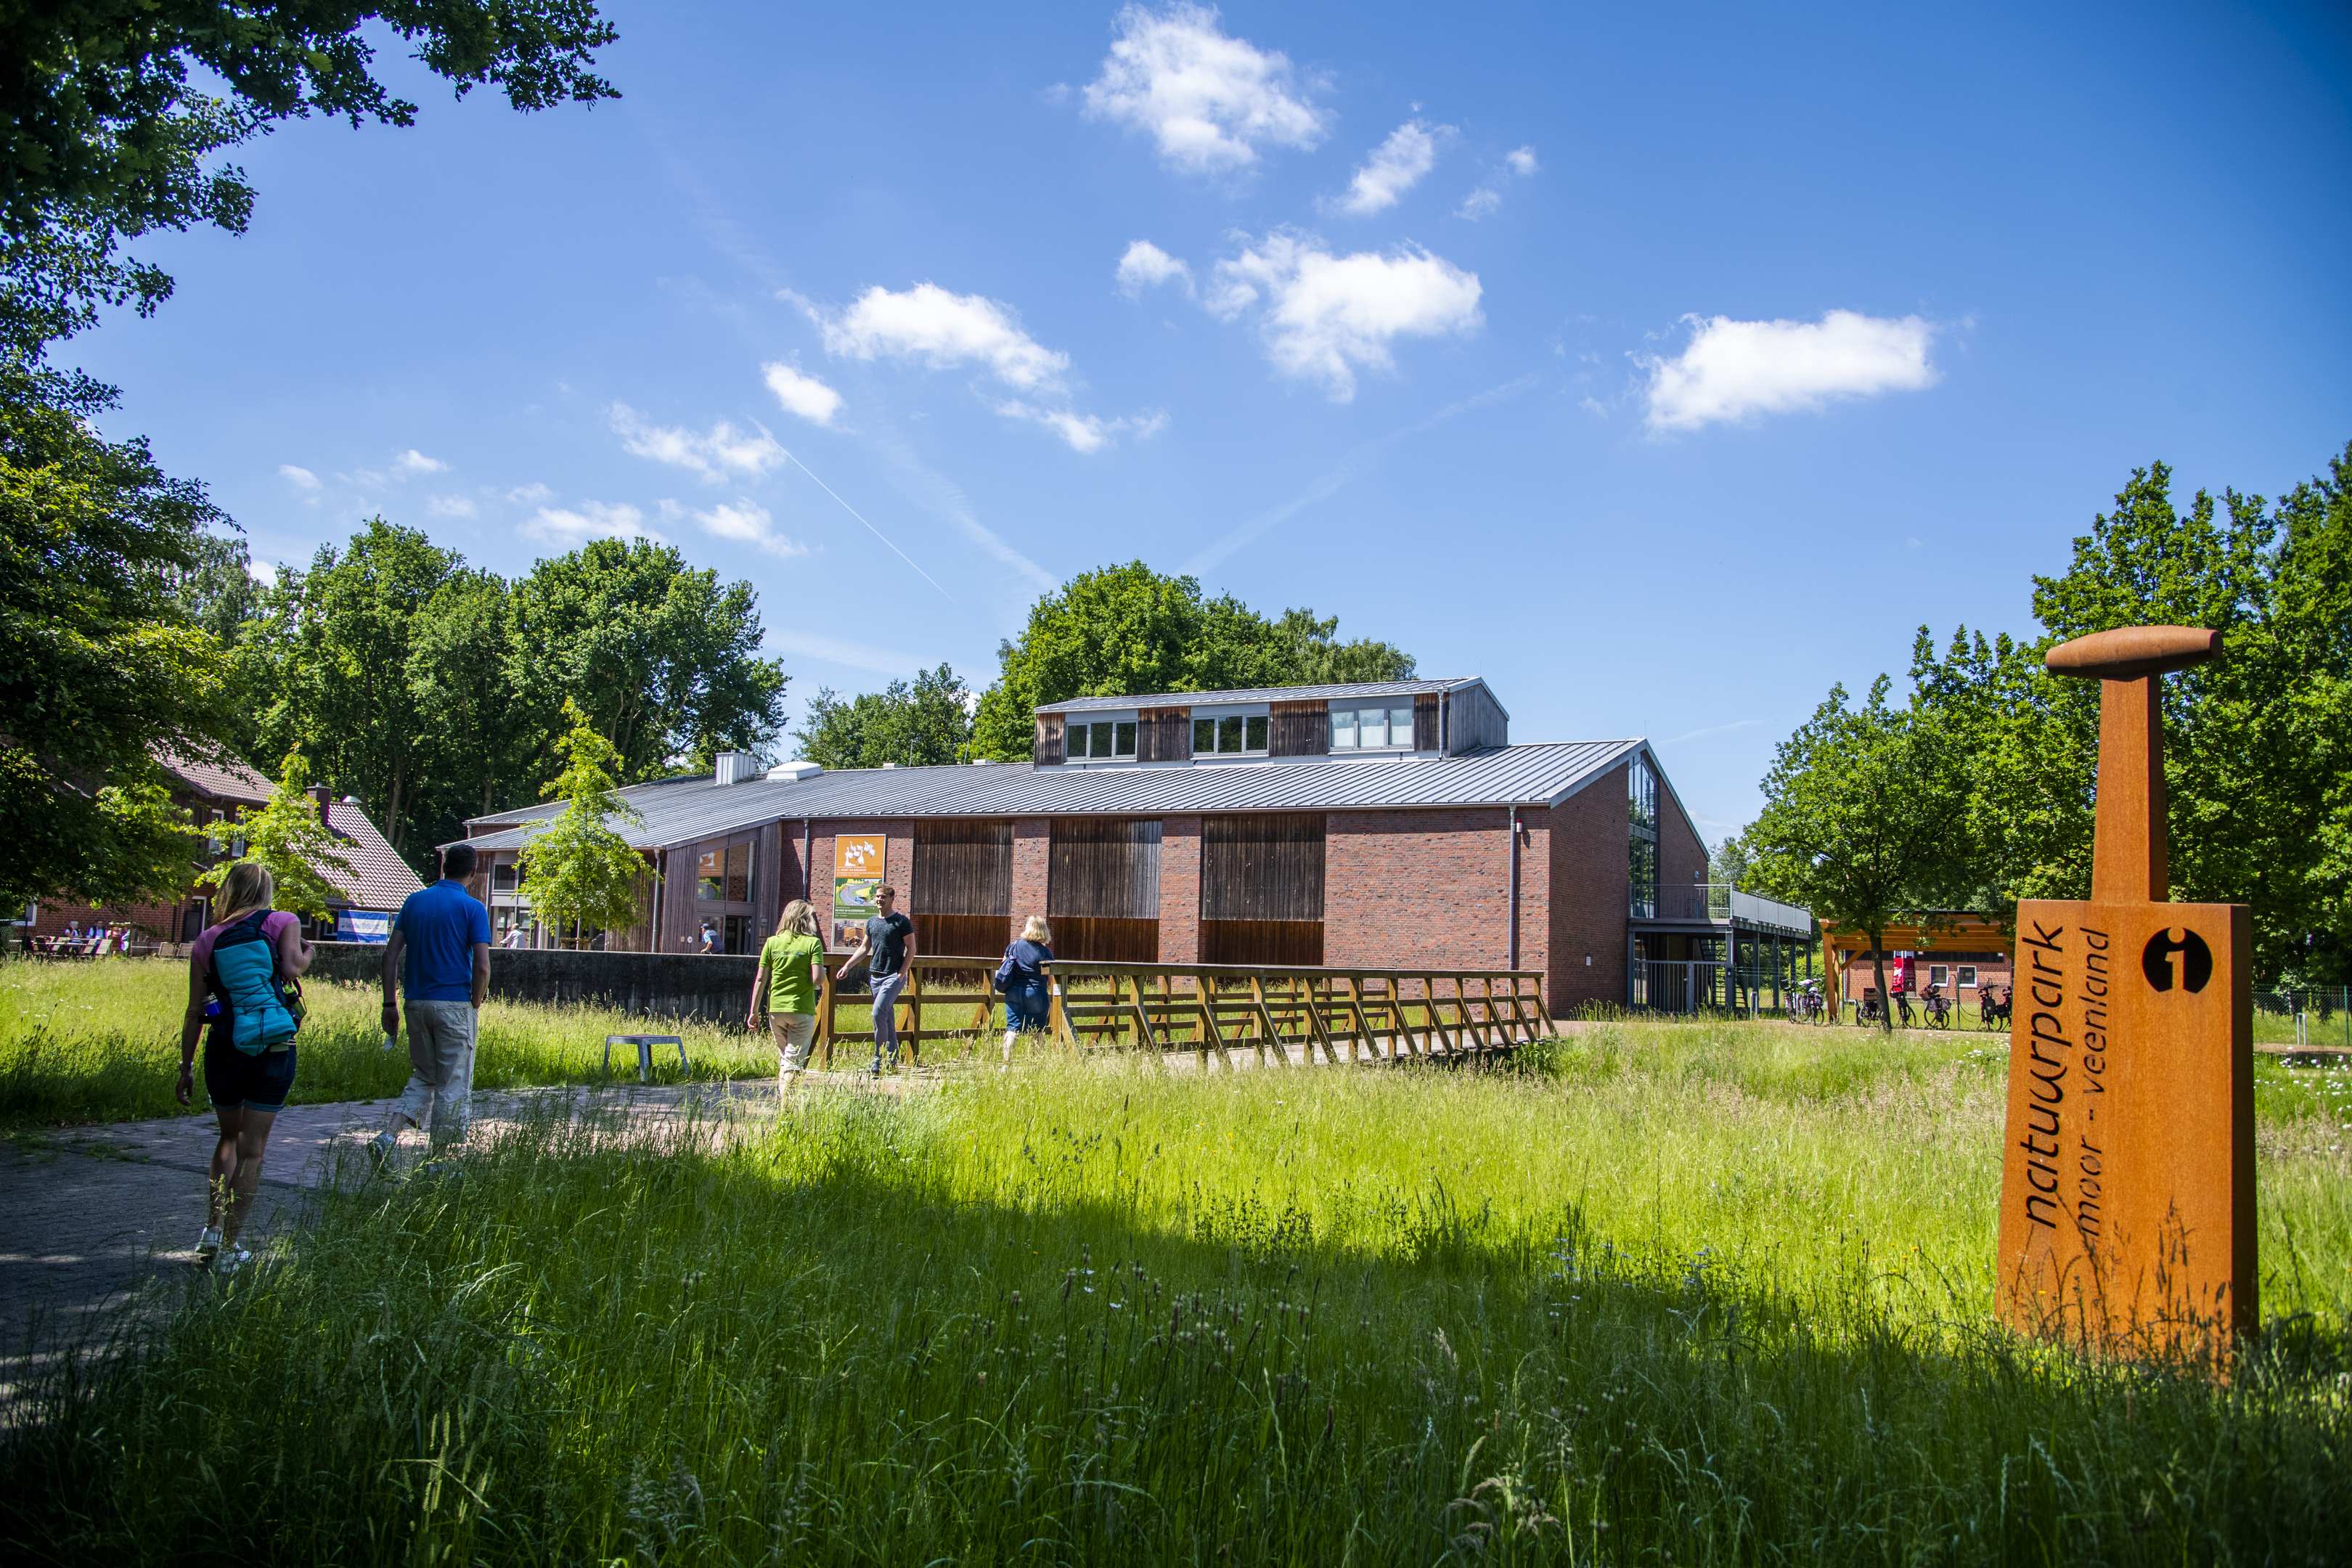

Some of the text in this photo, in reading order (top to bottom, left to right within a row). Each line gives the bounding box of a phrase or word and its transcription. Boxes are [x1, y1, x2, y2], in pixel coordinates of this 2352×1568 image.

[2020, 920, 2072, 1229] natuurpark
[2078, 927, 2108, 1236] moor - veenland
